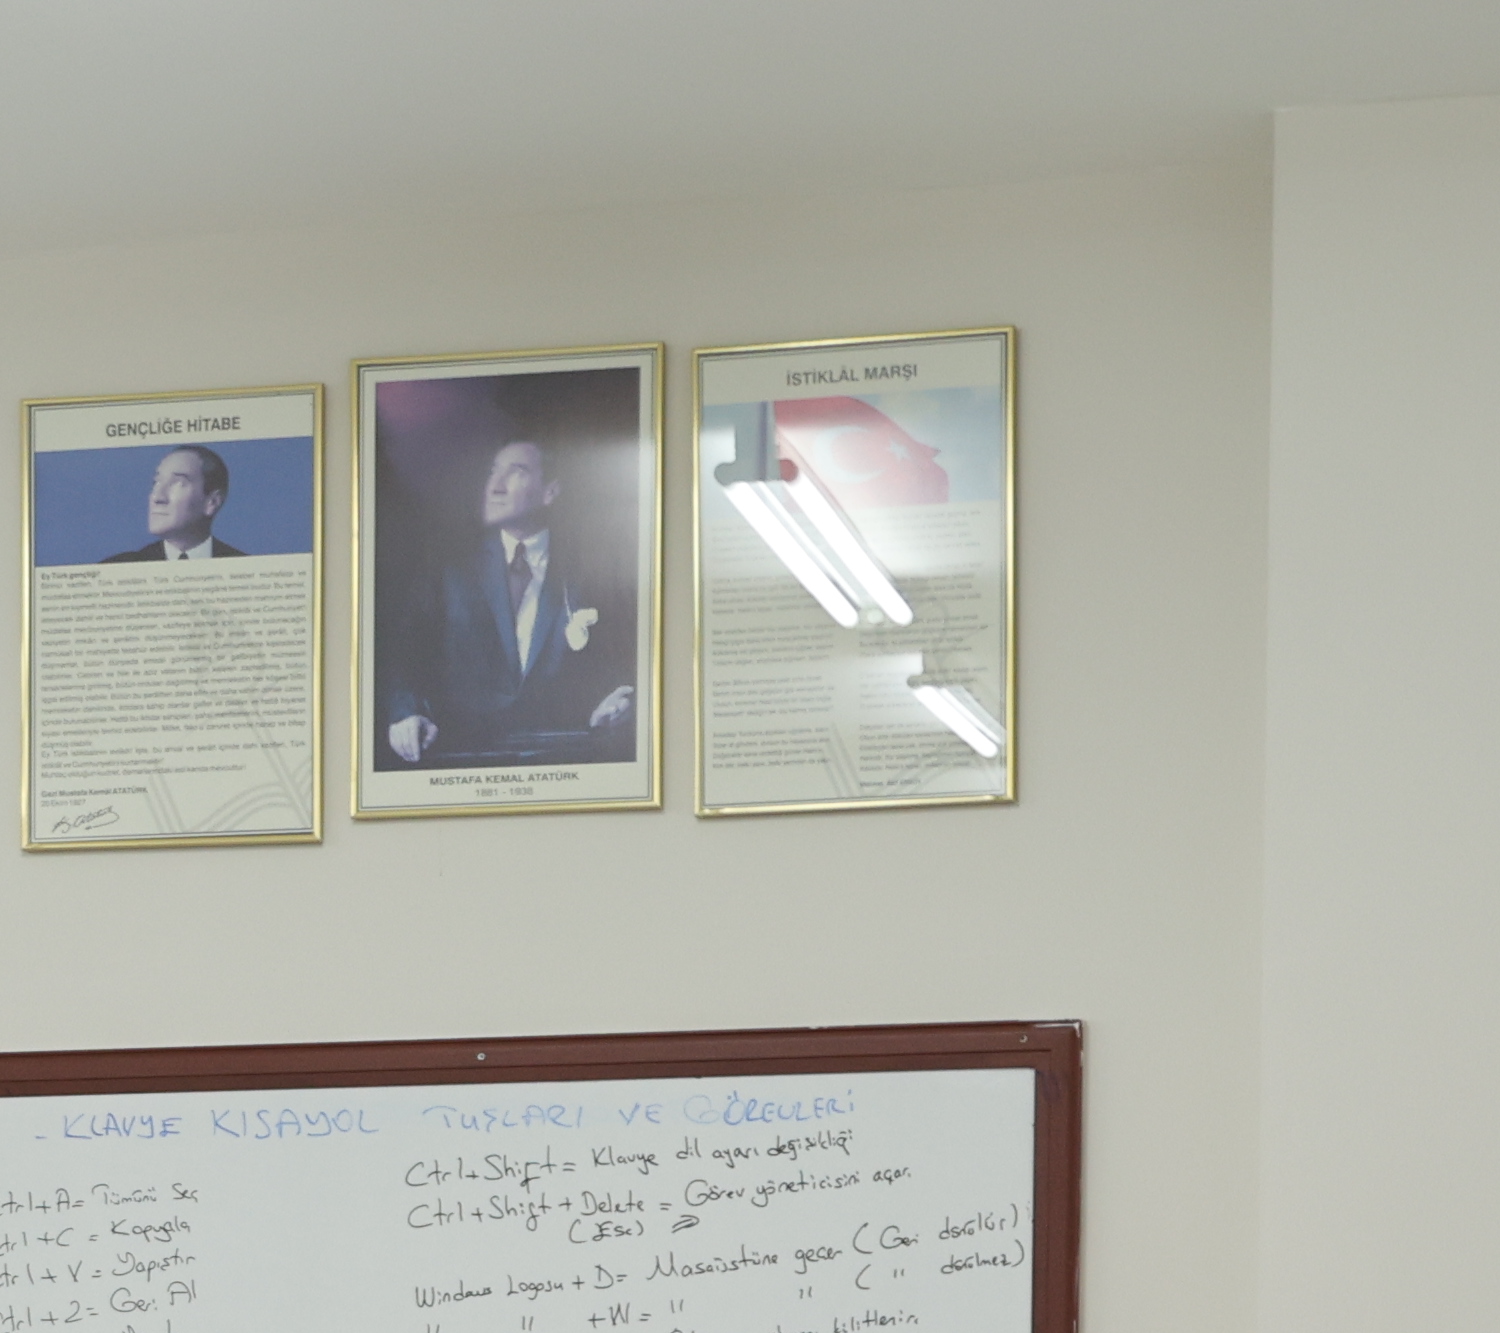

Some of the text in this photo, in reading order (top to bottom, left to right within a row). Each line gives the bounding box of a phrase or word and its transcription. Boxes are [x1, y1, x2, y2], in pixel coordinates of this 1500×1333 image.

[786, 363, 918, 387] İSTİKLÂL MARŞI
[105, 414, 241, 439] GENÇLİĞE HİTABE
[429, 770, 580, 787] MUSTAFA KEMAL ATATÜRK
[476, 788, 498, 797] 1881
[62, 1113, 184, 1141] KLAVYE
[210, 1107, 381, 1140] KISAYOL
[618, 1101, 663, 1126] VE
[591, 1146, 659, 1176] Klavye
[675, 1136, 702, 1160] dil
[580, 1190, 646, 1217] Delete
[684, 1178, 746, 1208] Görev
[166, 1278, 198, 1305] Al
